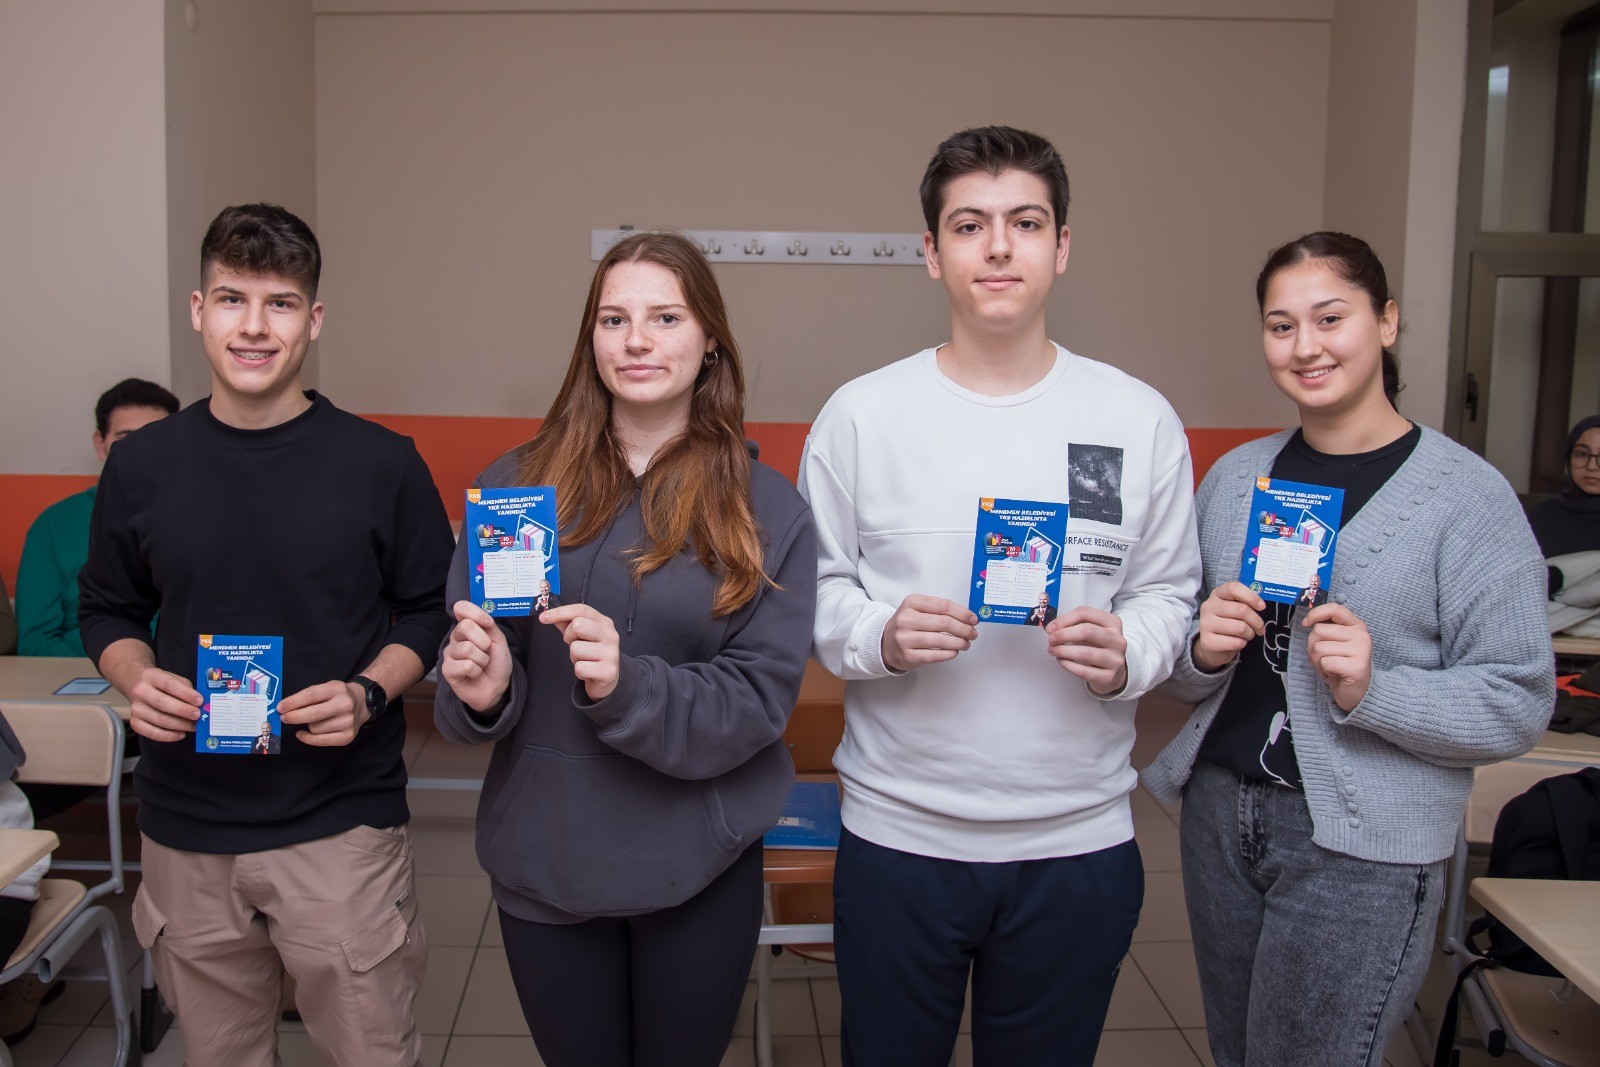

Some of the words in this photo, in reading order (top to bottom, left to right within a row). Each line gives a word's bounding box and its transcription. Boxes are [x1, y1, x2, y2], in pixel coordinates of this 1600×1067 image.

[1286, 497, 1322, 505] HAZIRLIKTA
[1064, 537, 1092, 545] URFACE
[1095, 538, 1129, 551] RESISTANCE
